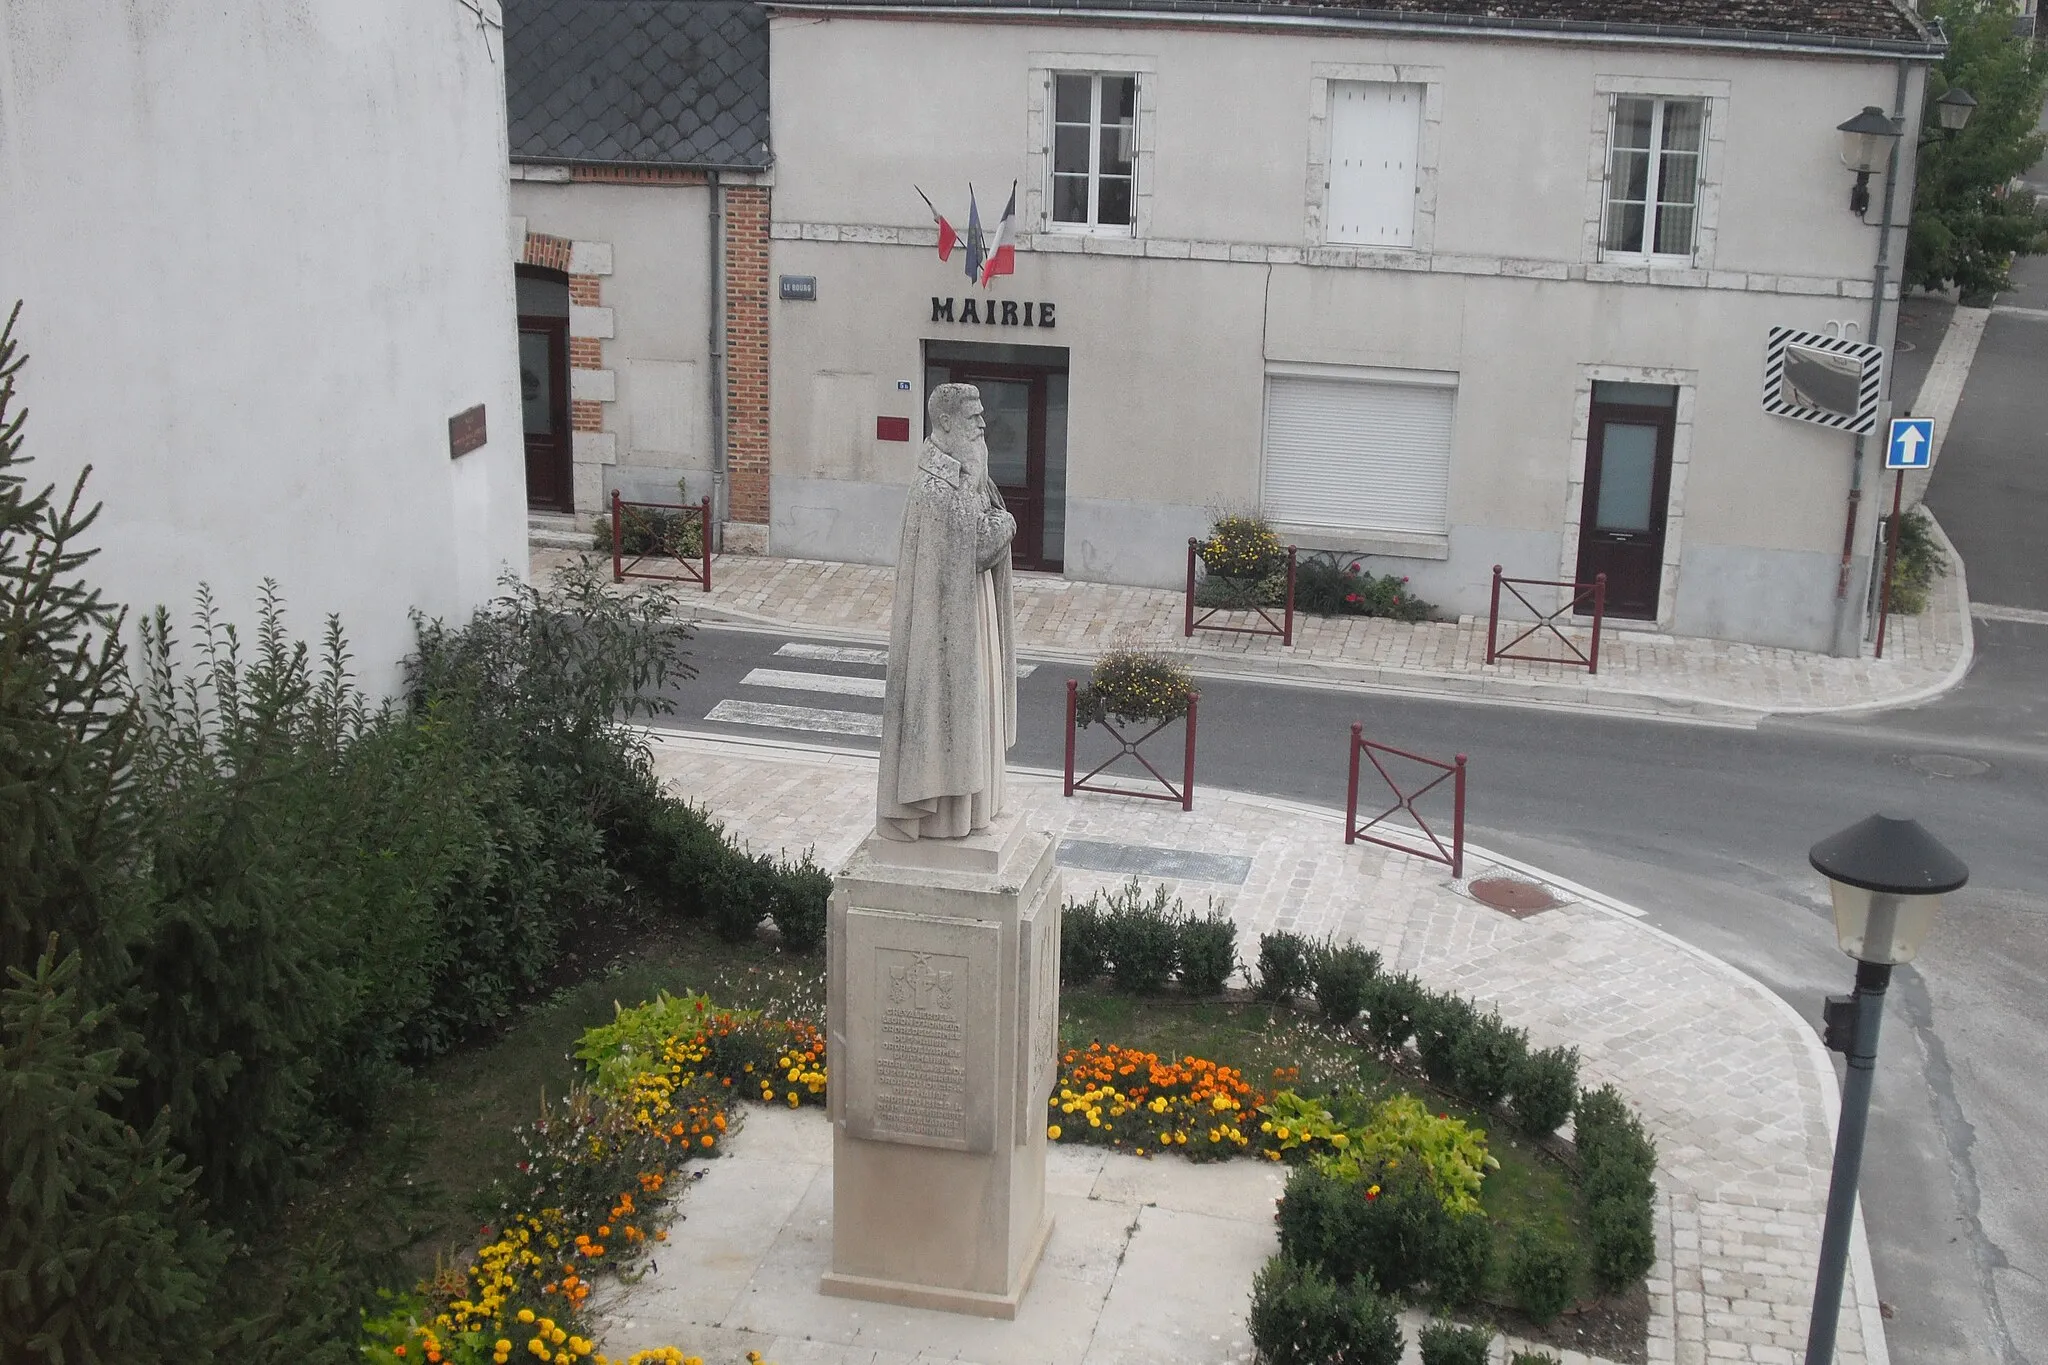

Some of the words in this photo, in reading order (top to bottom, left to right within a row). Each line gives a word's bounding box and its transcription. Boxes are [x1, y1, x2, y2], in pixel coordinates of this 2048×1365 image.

[783, 283, 791, 292] LE
[791, 283, 812, 292] BOURG
[932, 297, 1056, 328] MAIRIE
